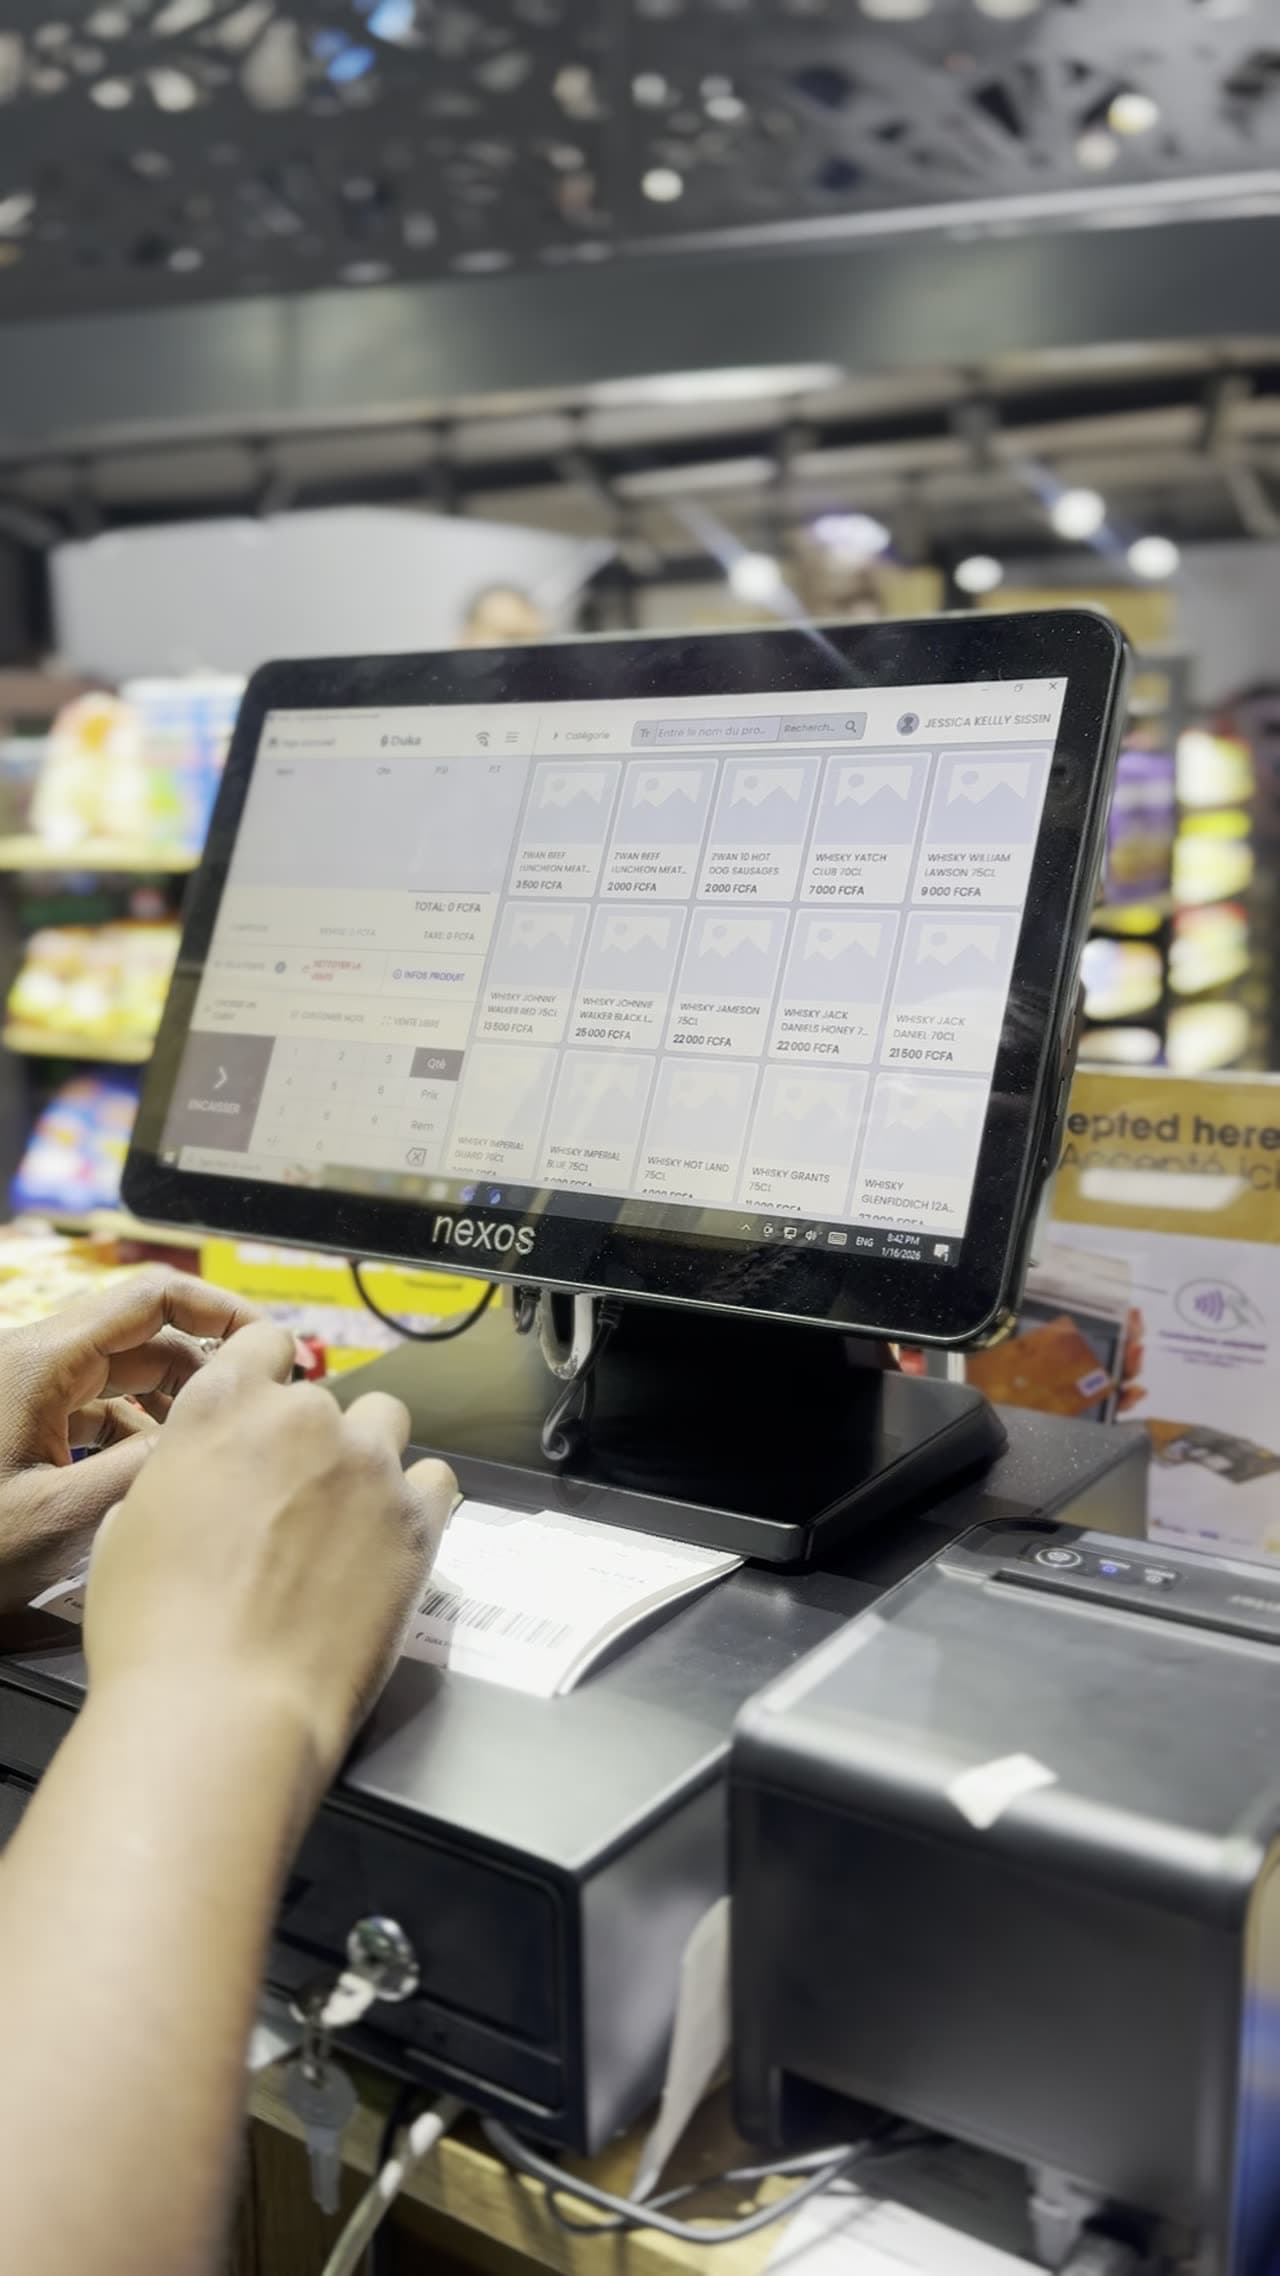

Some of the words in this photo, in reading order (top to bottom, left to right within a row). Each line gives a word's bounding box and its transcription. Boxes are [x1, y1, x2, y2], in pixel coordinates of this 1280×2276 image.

[925, 716, 970, 728] JESSICA
[1013, 713, 1052, 724] SISSIN
[725, 726, 739, 738] du
[751, 853, 771, 861] HOT
[816, 853, 852, 862] WHISKY
[854, 853, 887, 862] YATCH
[927, 853, 966, 862] WHISKY
[969, 853, 1011, 862] WILLIAM
[709, 866, 730, 875] DOG
[732, 866, 779, 875] SAUSAGES
[812, 867, 838, 876] CLUB
[924, 868, 969, 877] LAWSON
[540, 880, 562, 889] FCFA
[633, 882, 657, 891] FCFA
[733, 884, 757, 893] FCFA
[838, 886, 865, 895] FCFA
[953, 887, 981, 896] FCFA
[447, 901, 456, 912] 0
[456, 902, 481, 912] FCFA
[446, 931, 453, 941] 0
[454, 931, 475, 941] FCFA
[404, 970, 428, 980] INFOS
[429, 971, 465, 982] PRODUIT
[490, 992, 520, 1001] WHISKY
[583, 997, 615, 1006] WHISKY
[680, 1003, 714, 1012] WHISKY
[715, 1005, 760, 1015] JAMESON
[784, 1008, 821, 1018] WHISKY
[822, 1010, 849, 1020] JACK
[580, 1011, 613, 1020] WALKER
[614, 1013, 642, 1022] BLACK
[896, 1014, 936, 1024] WHISKY
[937, 1016, 966, 1026] JACK
[511, 1023, 534, 1033] FCFA
[781, 1022, 820, 1033] DANIELS
[821, 1024, 856, 1035] HONEY
[607, 1030, 632, 1040] FCFA
[894, 1029, 927, 1040] DANIEL
[706, 1036, 732, 1047] FCFA
[813, 1043, 840, 1054] FCFA
[925, 1050, 953, 1061] FCFA
[427, 1057, 447, 1070] Qté
[1192, 1113, 1280, 1151] here
[550, 1146, 582, 1157] WHISKY
[583, 1149, 621, 1161] IMPERIAL
[648, 1156, 682, 1167] WHISKY
[683, 1160, 704, 1170] HOT
[704, 1162, 729, 1172] LAND
[753, 1167, 789, 1178] WHISKY
[790, 1171, 830, 1183] GRANTS
[749, 1182, 772, 1192] 75CL
[864, 1178, 904, 1191] WHISKY
[861, 1194, 929, 1210] GLENFIDDICH
[432, 1215, 536, 1255] nexos
[905, 1234, 920, 1245] PM
[856, 1236, 874, 1247] ENG
[881, 1247, 921, 1261] 1/16/2026
